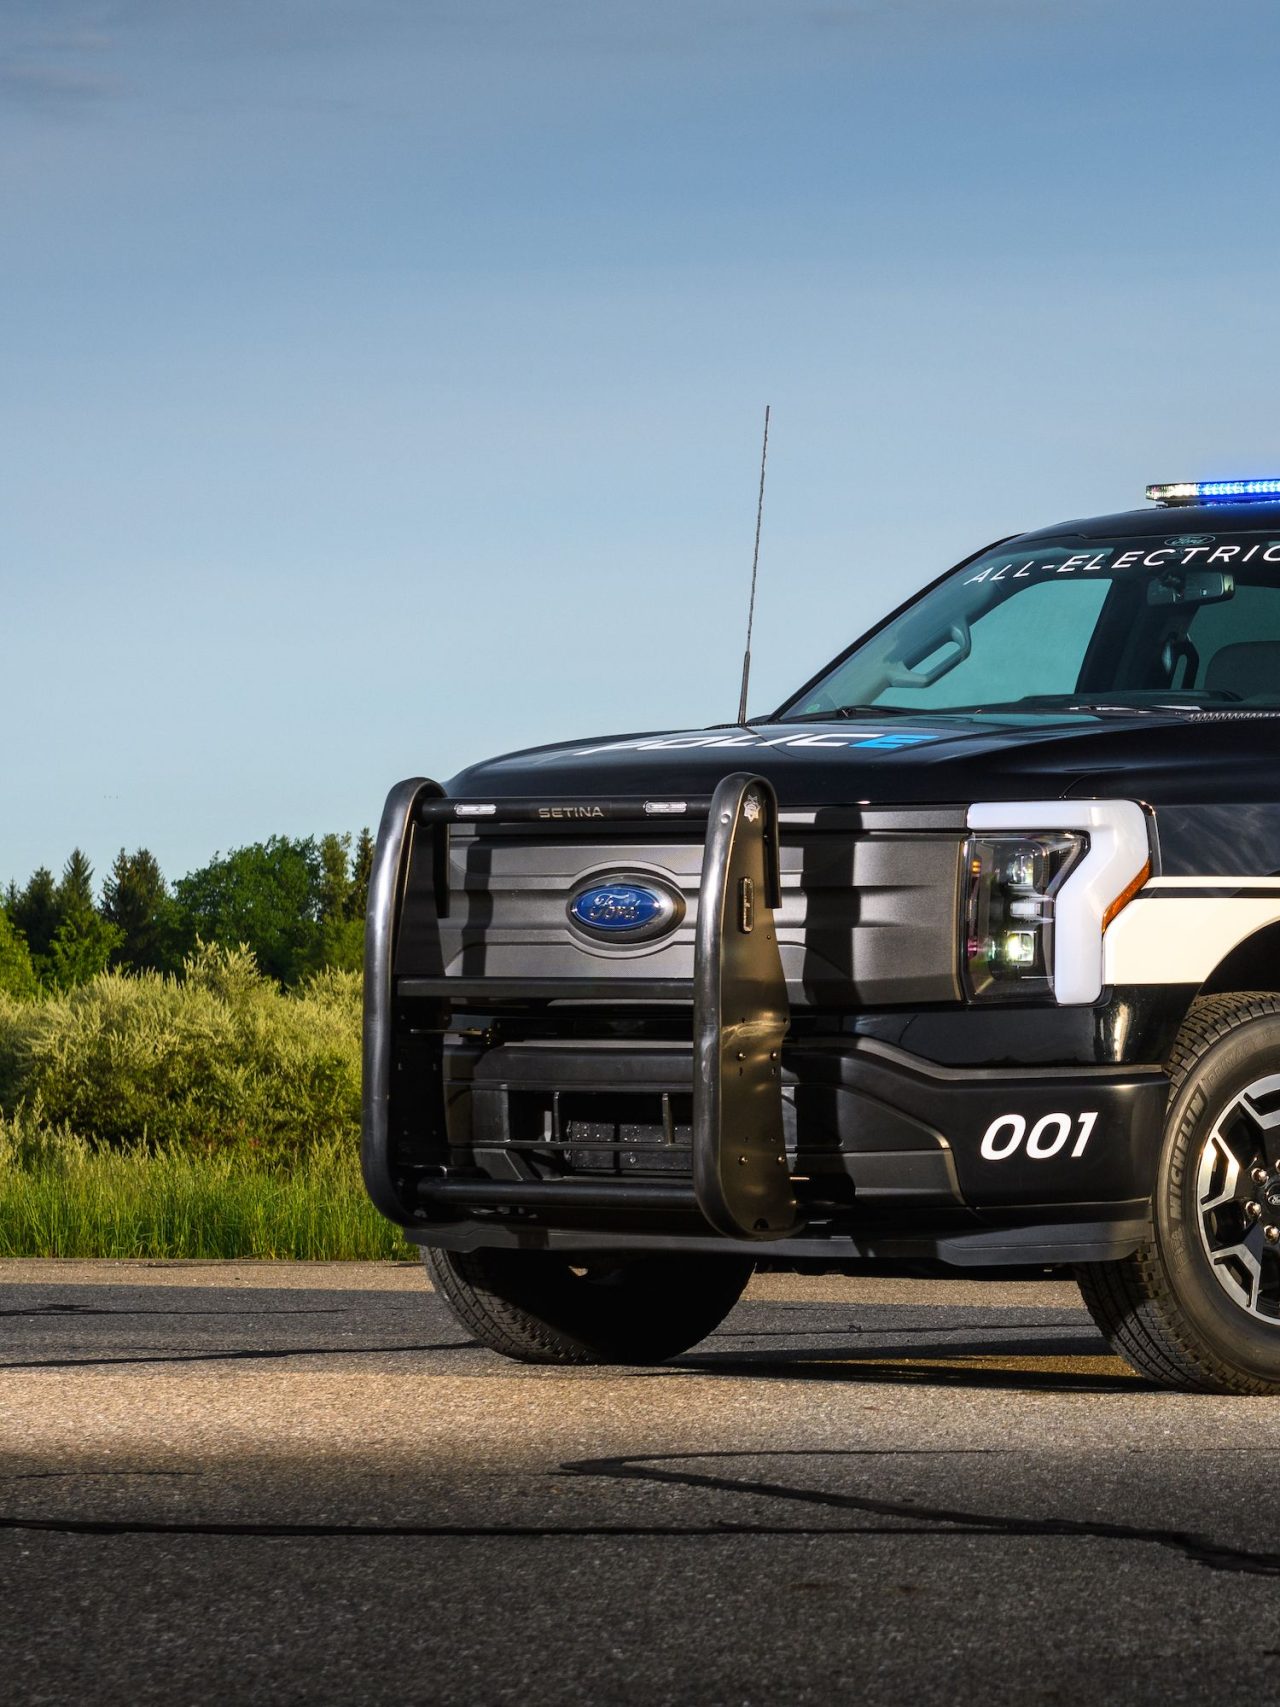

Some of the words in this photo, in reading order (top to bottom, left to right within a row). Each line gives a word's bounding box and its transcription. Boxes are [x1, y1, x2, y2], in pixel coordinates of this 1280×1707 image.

[573, 733, 941, 756] POLICE
[538, 805, 605, 819] SETINA
[980, 1112, 1099, 1161] 001
[1170, 1090, 1206, 1220] MICHELIN
